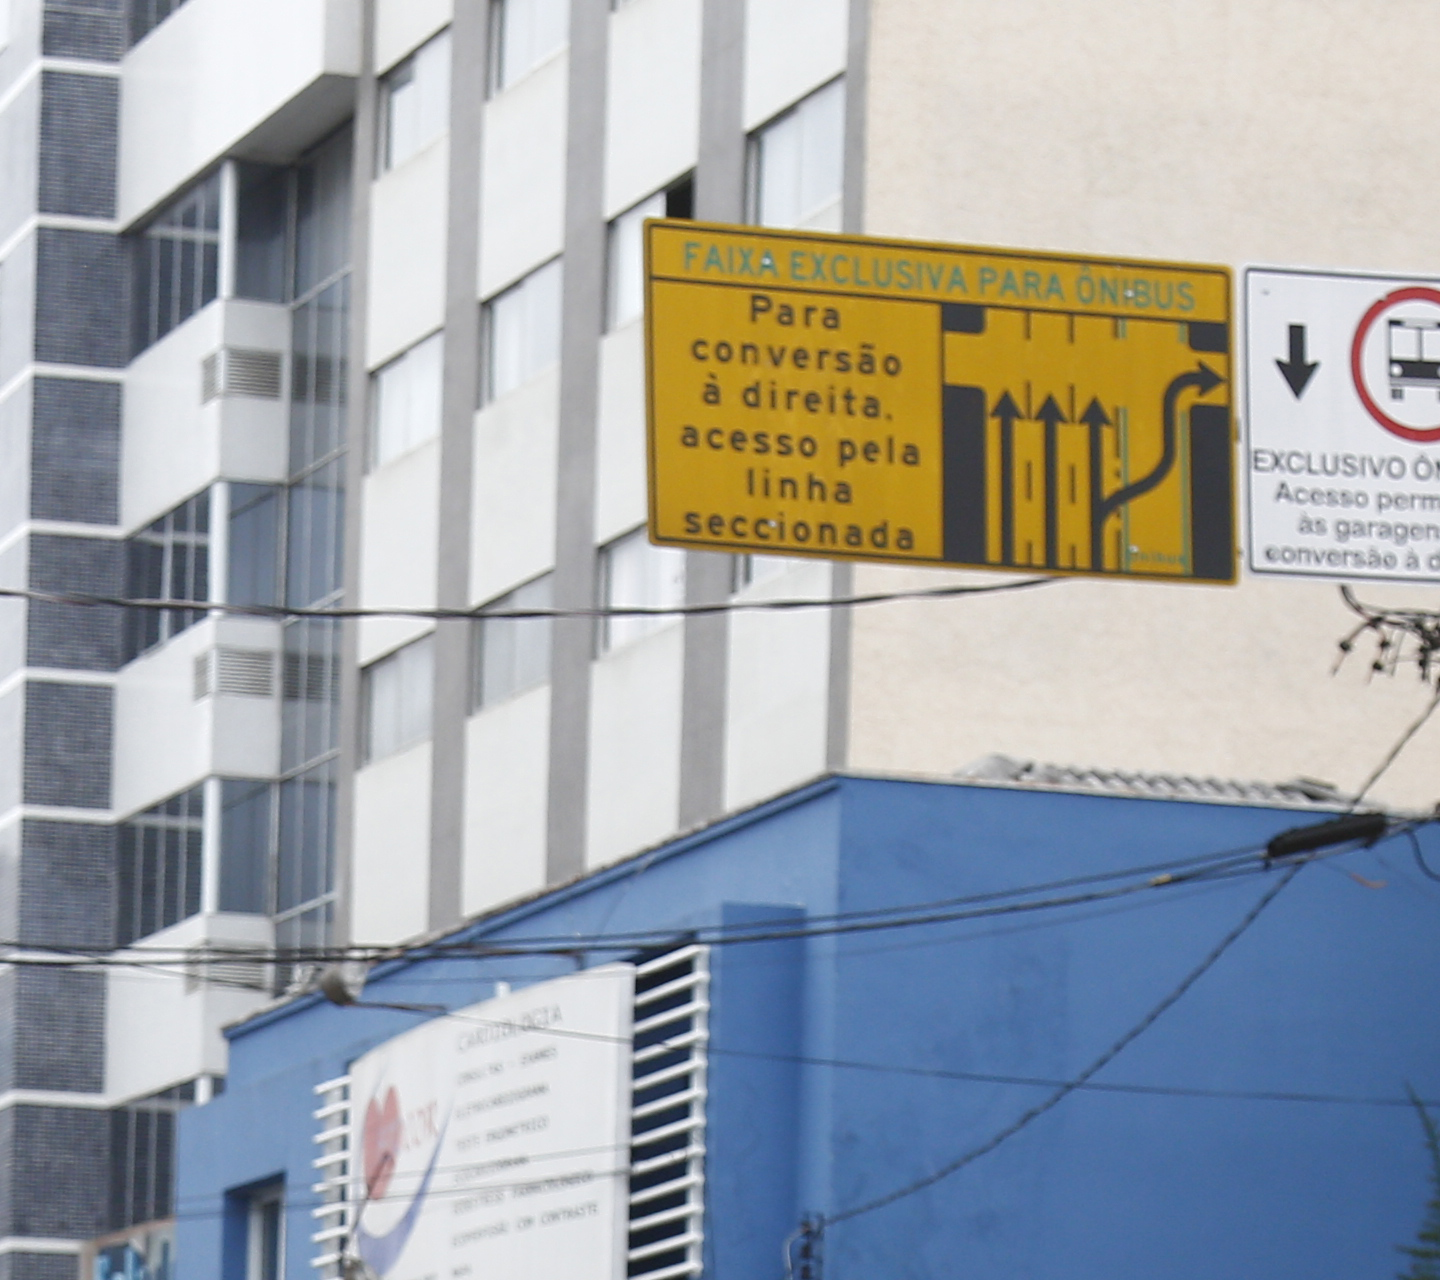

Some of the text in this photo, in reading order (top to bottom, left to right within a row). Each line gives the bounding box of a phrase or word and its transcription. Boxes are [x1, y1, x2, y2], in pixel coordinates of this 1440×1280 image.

[682, 241, 1196, 311] FAIXA EXCLUSIVA PARA ÔNIBUS
[749, 294, 842, 330] Para
[691, 338, 902, 377] conversão
[681, 420, 920, 467] acesso pela
[1254, 449, 1407, 480] EXCLUSIVO
[746, 469, 853, 504] linha
[1276, 481, 1369, 508] Acesso
[684, 510, 915, 551] seccionada
[1264, 546, 1398, 570] conversão
